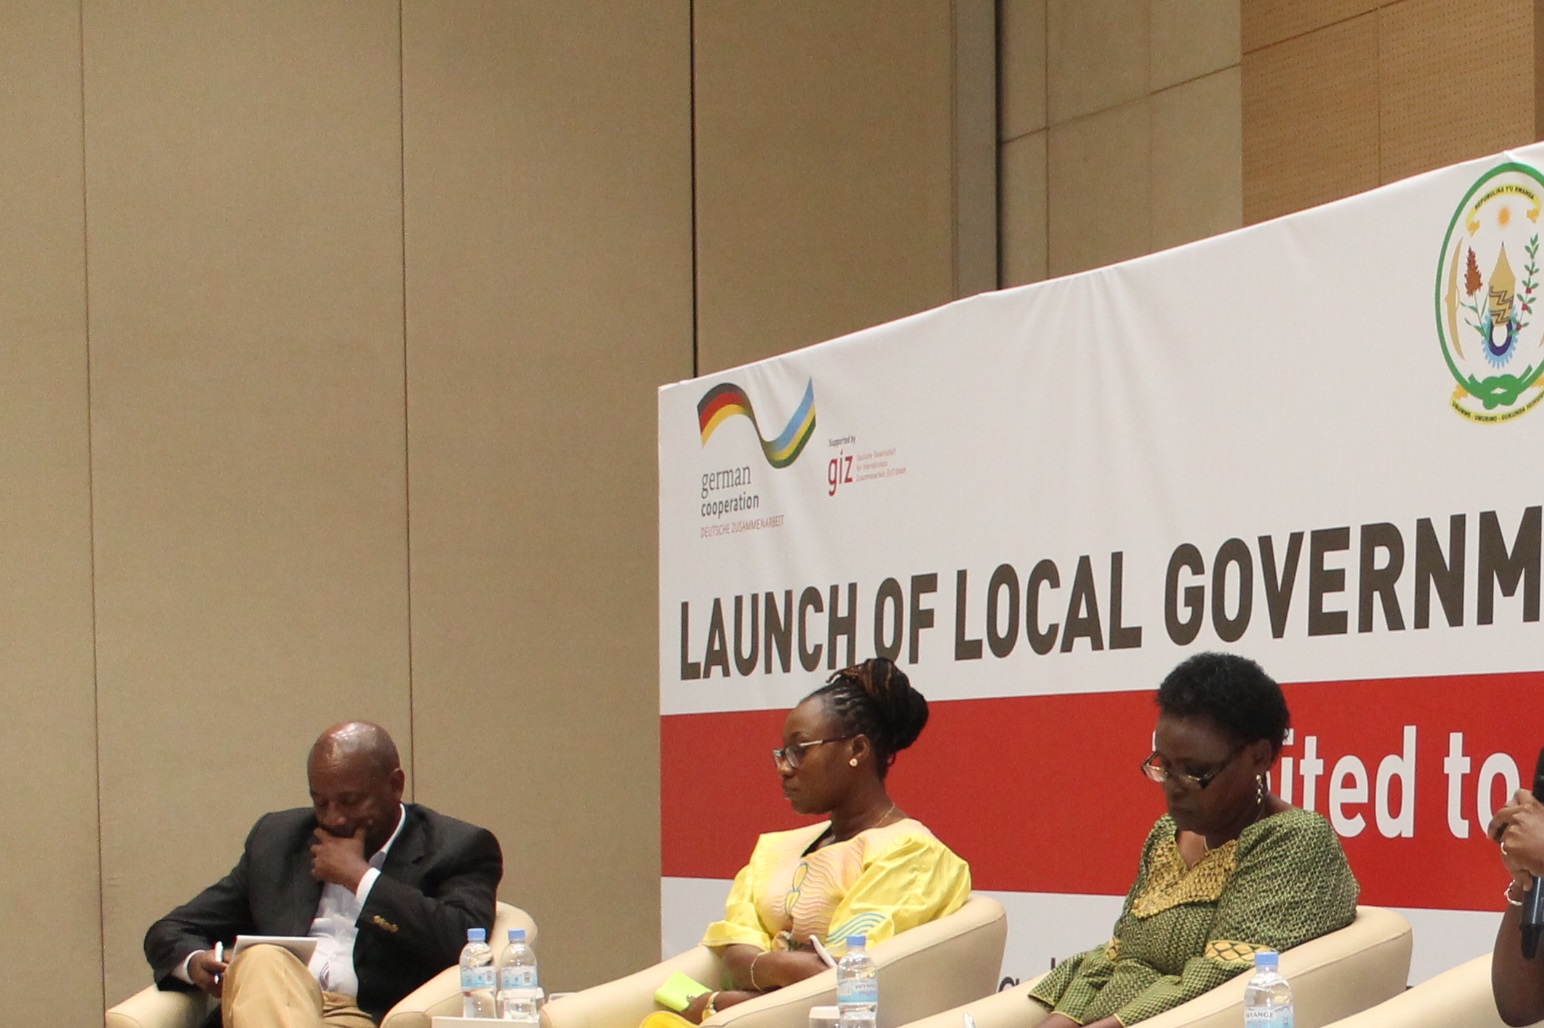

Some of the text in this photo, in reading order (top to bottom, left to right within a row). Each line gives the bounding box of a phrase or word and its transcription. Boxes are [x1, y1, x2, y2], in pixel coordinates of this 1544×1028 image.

[701, 465, 751, 499] german
[828, 449, 854, 497] giz
[701, 491, 760, 519] cooperation
[680, 582, 858, 681] LAUNCH
[874, 572, 938, 665] OF
[955, 551, 1143, 662] LOCAL
